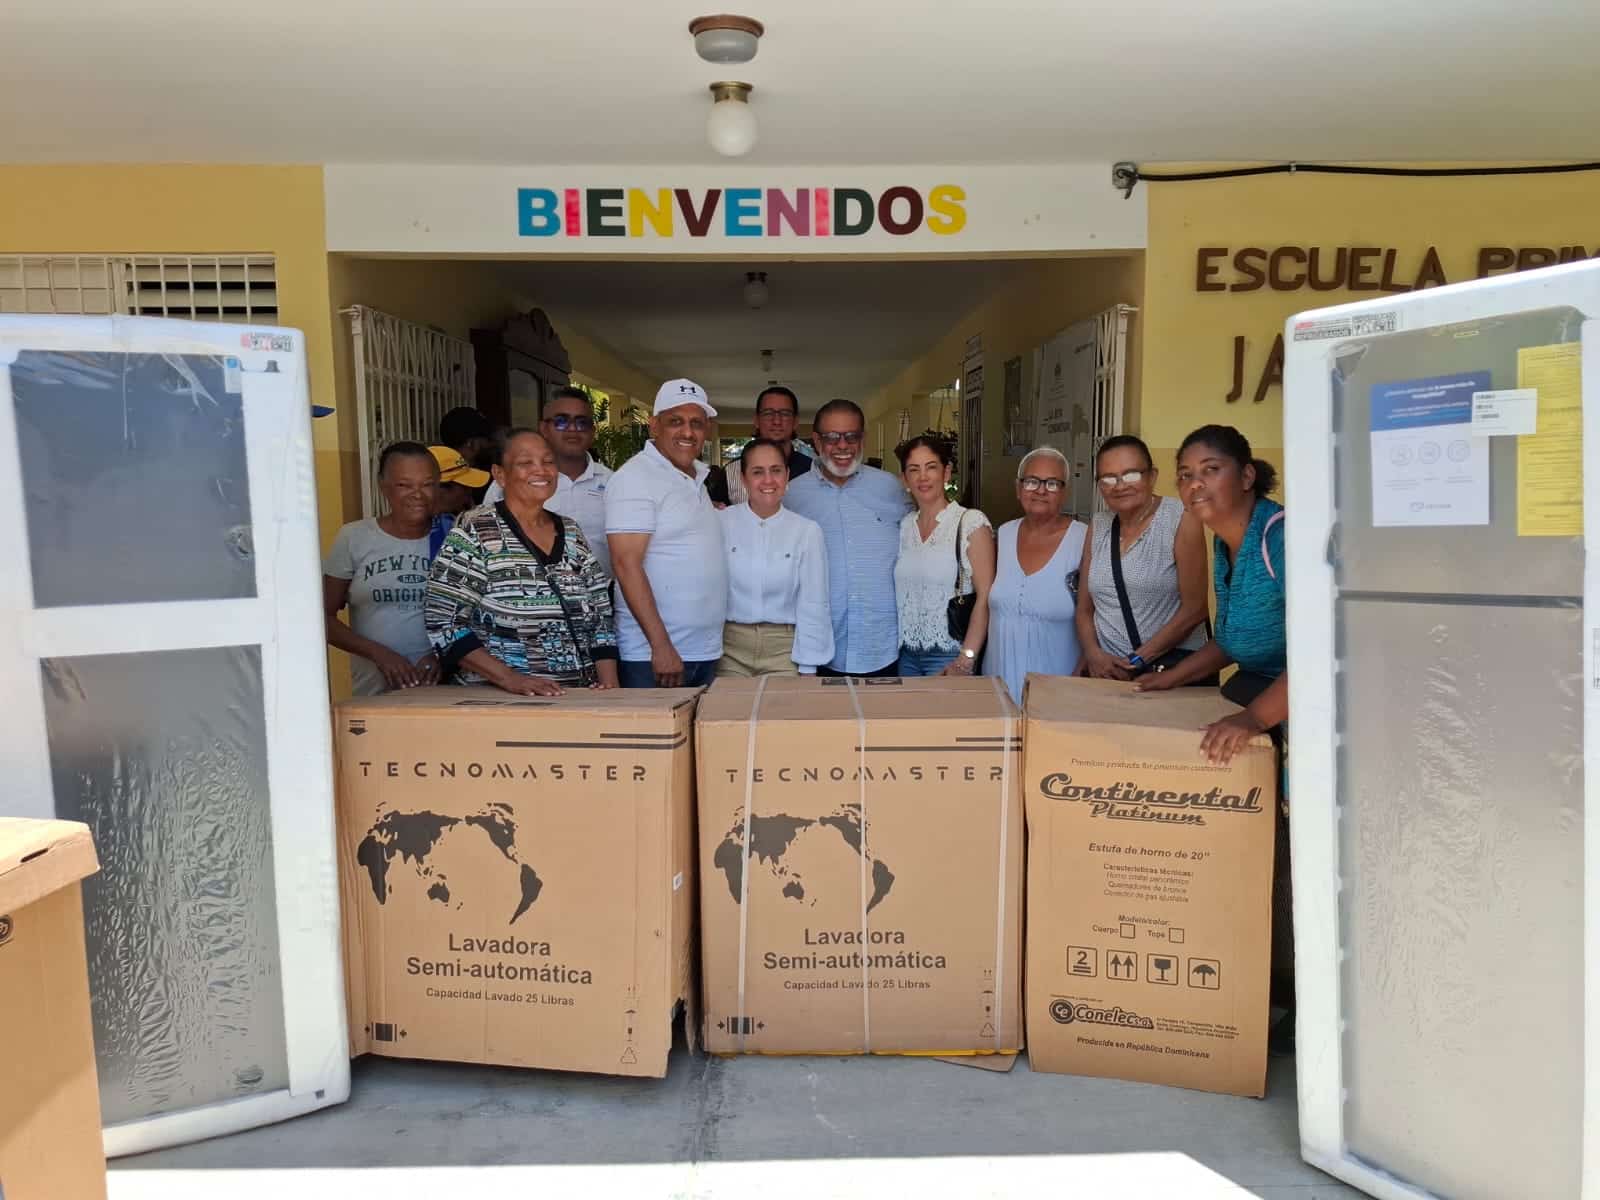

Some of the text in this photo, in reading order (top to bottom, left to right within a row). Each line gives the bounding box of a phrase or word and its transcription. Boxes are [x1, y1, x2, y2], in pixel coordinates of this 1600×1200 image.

[517, 184, 967, 237] BIENVENIDOS
[1196, 246, 1447, 292] ESCUELA
[364, 554, 404, 581] NEW
[359, 762, 648, 781] TECNOMASTER
[725, 765, 1004, 783] TECNOMASTER
[1040, 773, 1263, 813] Continental
[1089, 800, 1207, 825] Platinum
[1088, 842, 1122, 854] Estufa
[1124, 845, 1138, 855] de
[1139, 847, 1172, 858] horno
[1174, 849, 1189, 859] de
[448, 933, 551, 957] Lavadora
[804, 928, 905, 945] Lavadora
[406, 957, 592, 985] Semi-automática
[763, 951, 947, 970] Semi-automática
[783, 980, 839, 990] Capacidad
[883, 979, 895, 989] 25
[898, 979, 931, 990] Libras
[426, 987, 575, 1006] Capacidad Lavado 25 Libras
